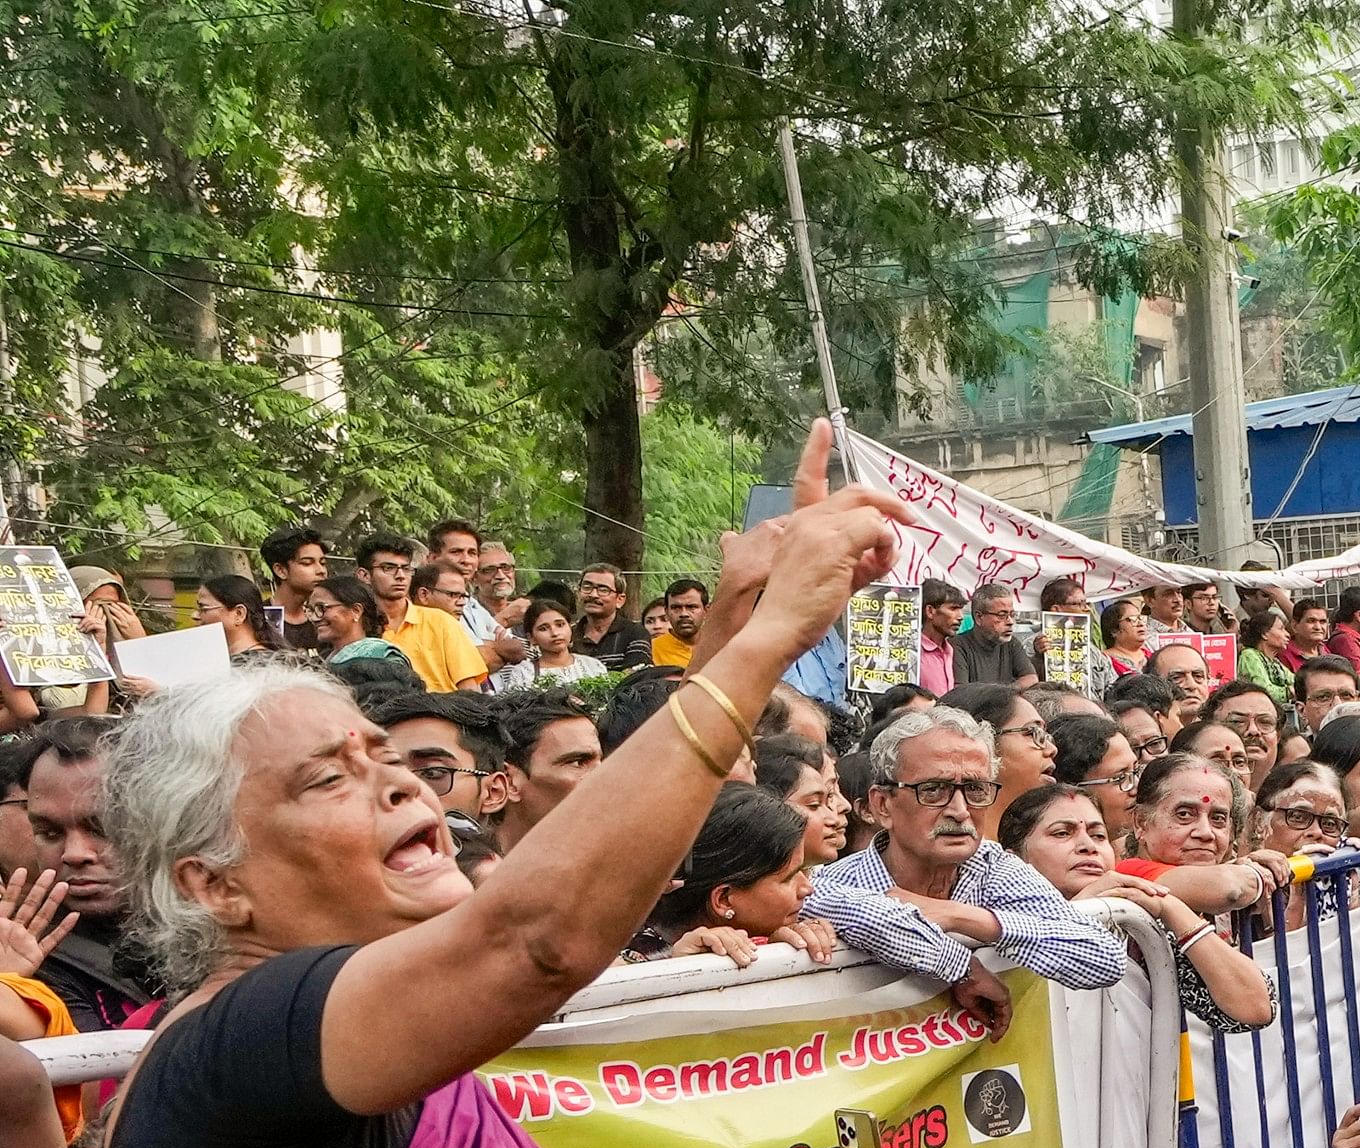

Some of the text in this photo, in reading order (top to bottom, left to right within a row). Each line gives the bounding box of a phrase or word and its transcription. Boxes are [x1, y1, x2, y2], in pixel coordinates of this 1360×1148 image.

[492, 1008, 988, 1121] We Demand Justic
